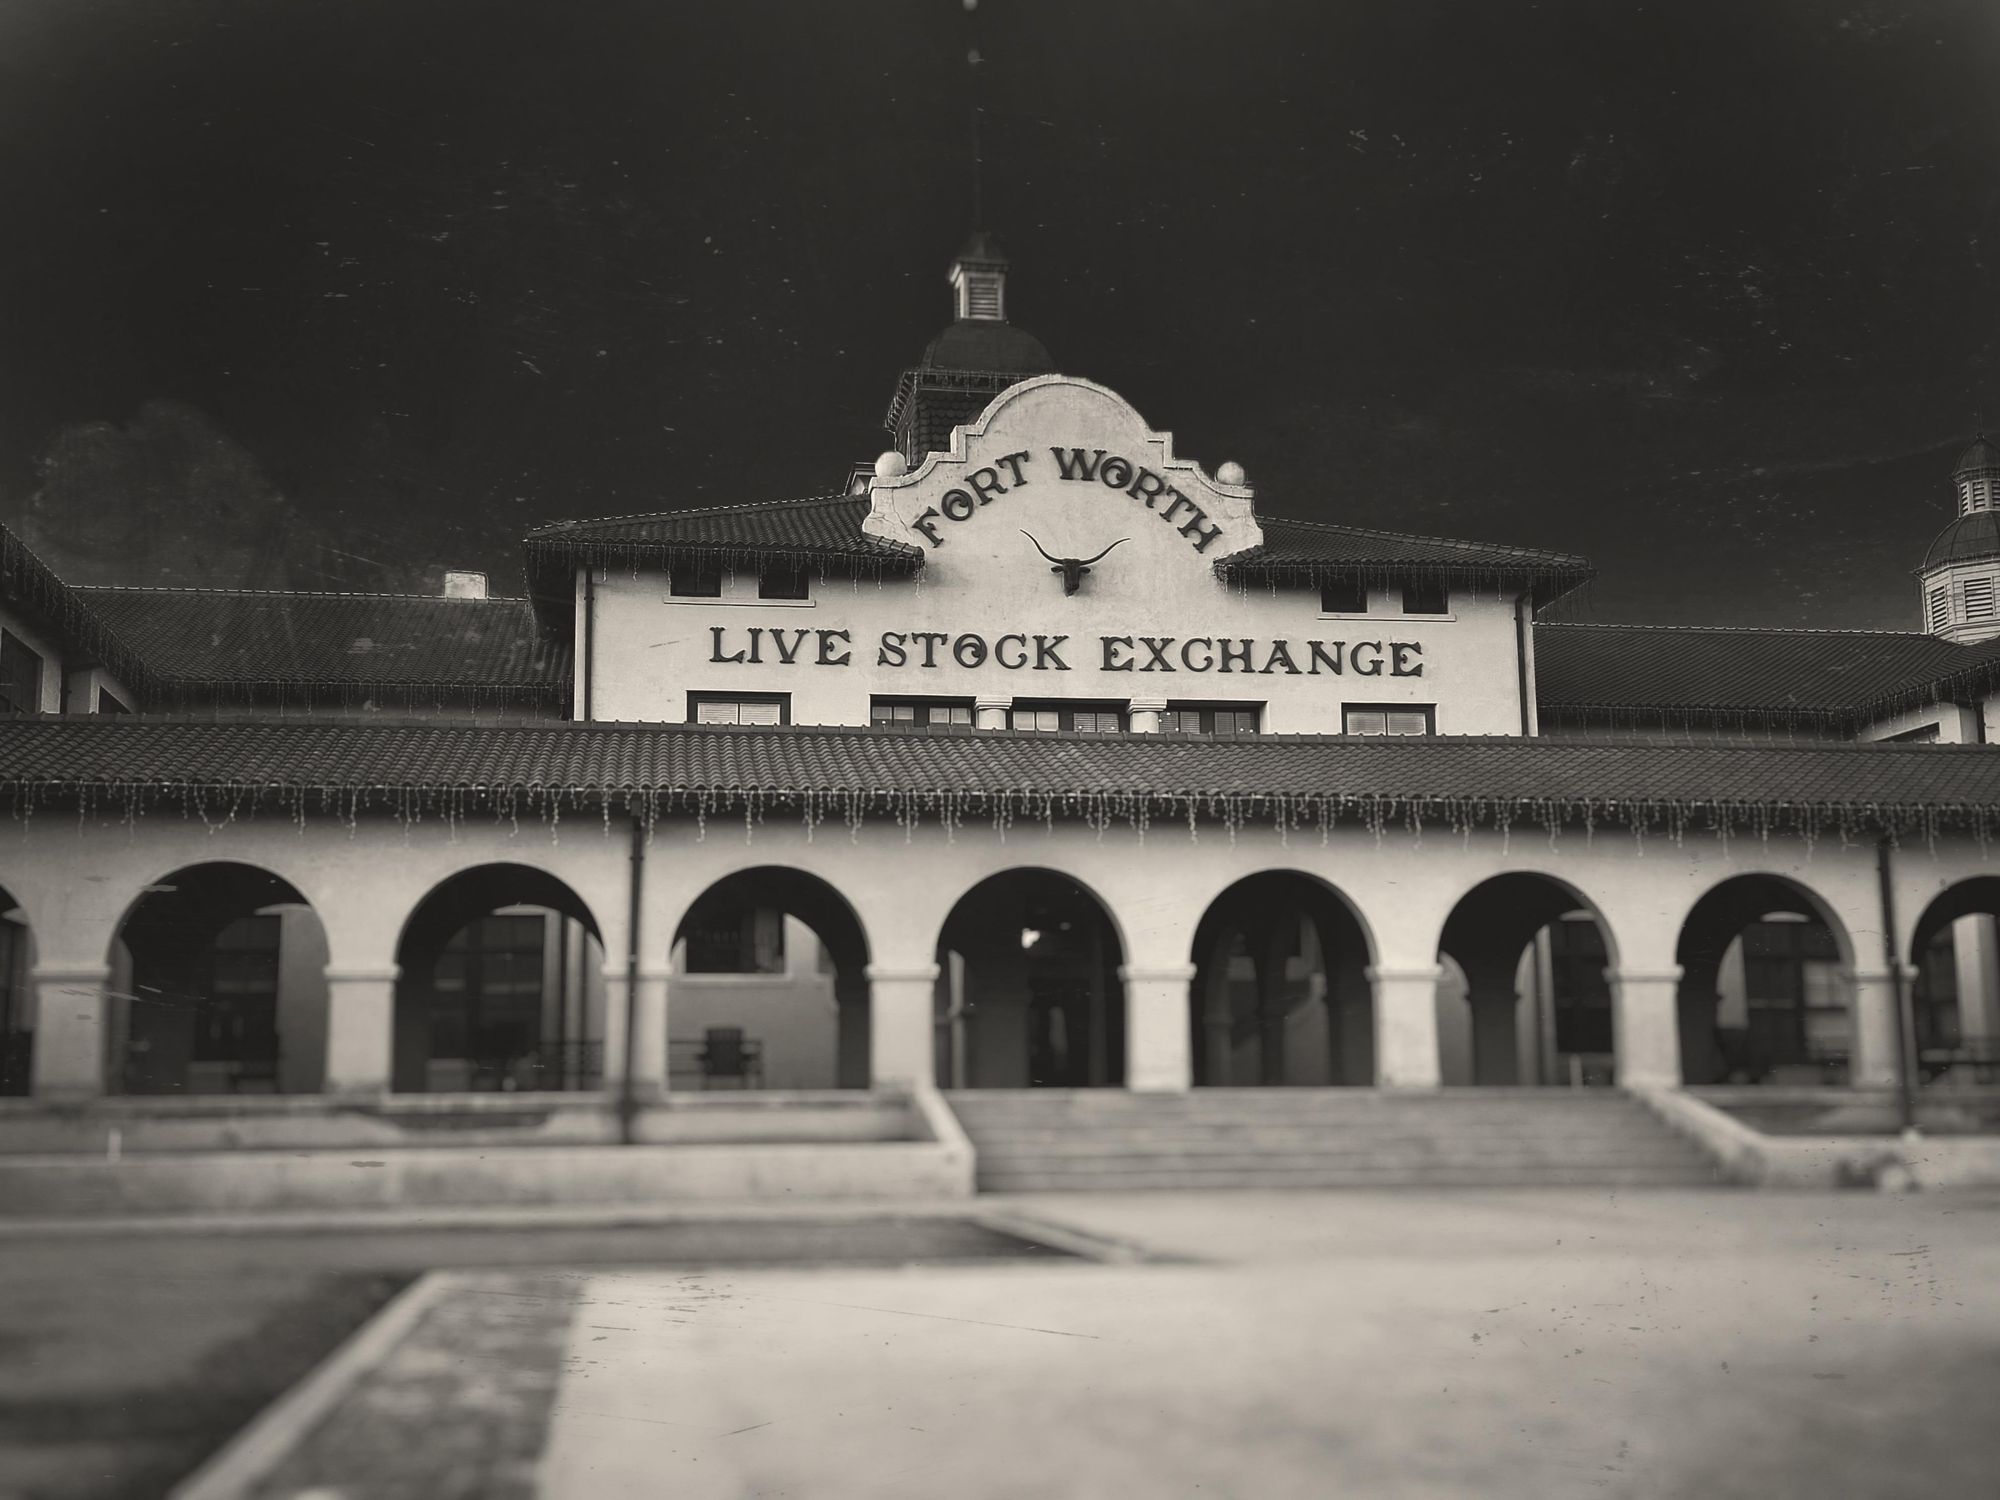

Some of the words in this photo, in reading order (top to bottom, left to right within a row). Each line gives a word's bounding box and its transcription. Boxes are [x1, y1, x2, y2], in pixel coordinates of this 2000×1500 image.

[911, 450, 1029, 549] FORT
[1050, 446, 1223, 554] WORTH
[709, 626, 852, 666] LIVE
[877, 631, 1072, 671] STOCK
[1099, 635, 1423, 677] EXCHANGE
